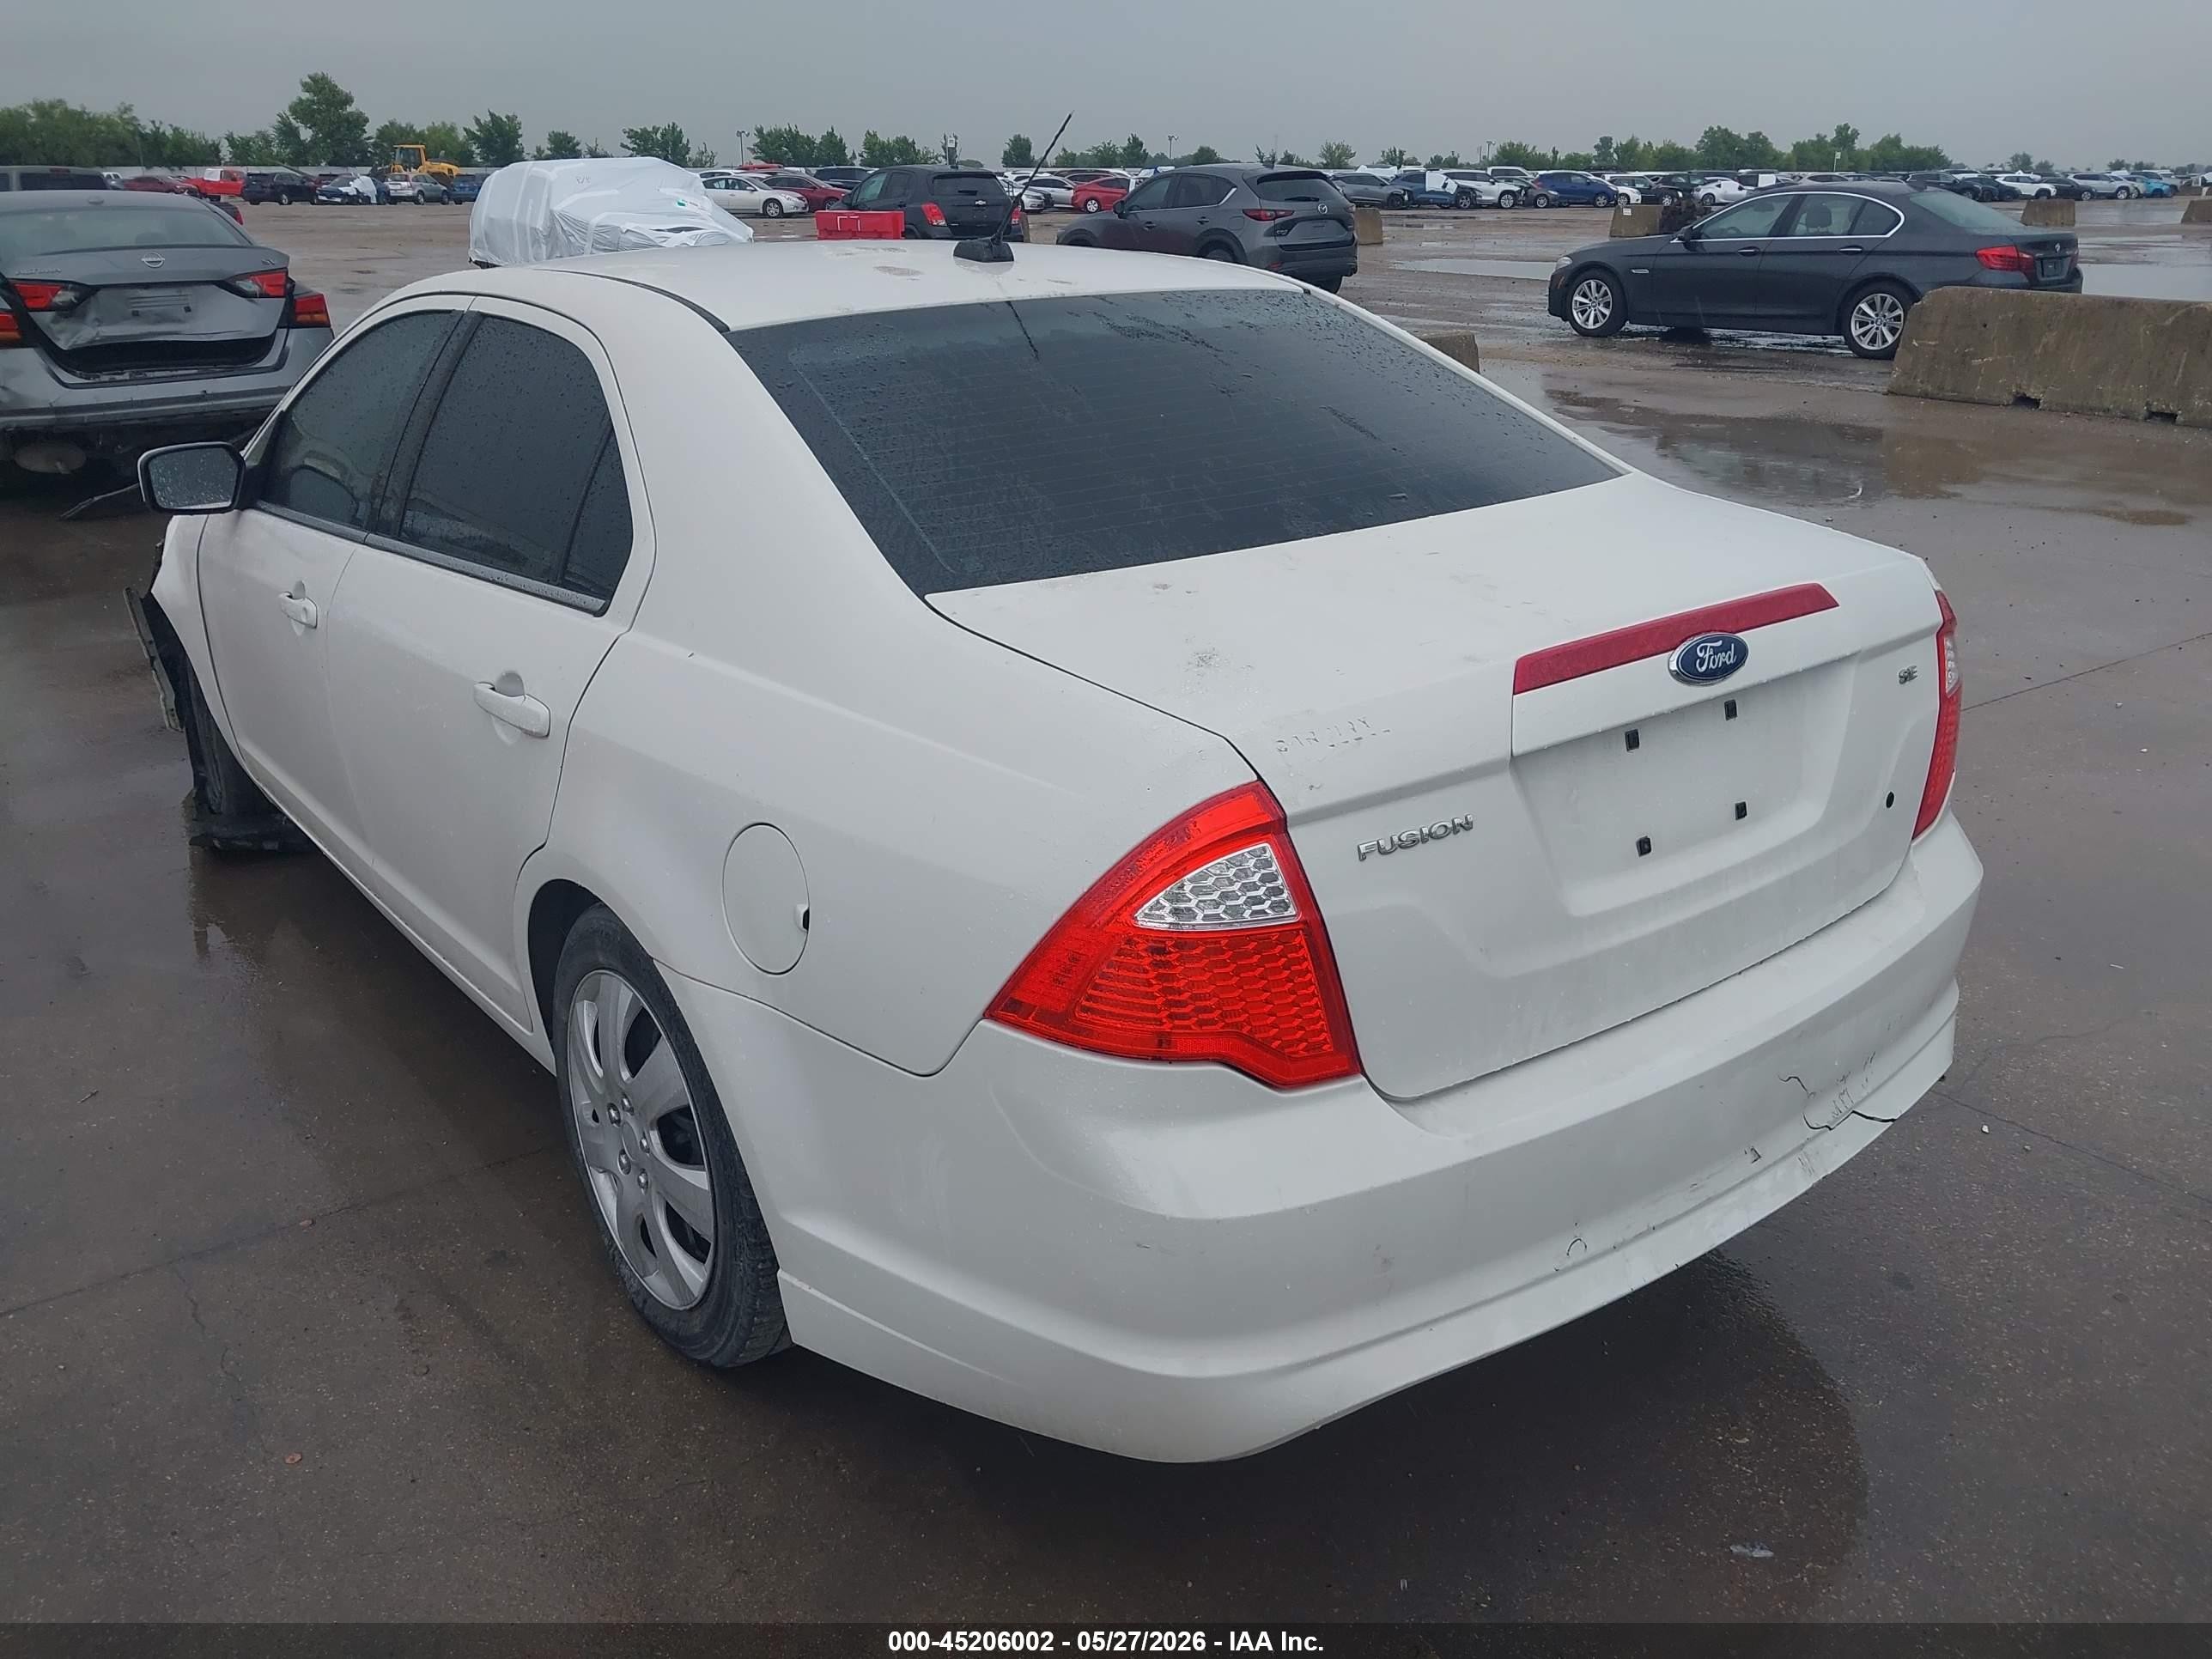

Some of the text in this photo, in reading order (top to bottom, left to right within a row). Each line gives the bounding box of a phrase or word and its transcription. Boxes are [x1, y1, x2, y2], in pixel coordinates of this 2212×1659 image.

[1695, 639, 1737, 673] Ford
[1898, 665, 1918, 685] SE
[1357, 813, 1474, 862] FUSION
